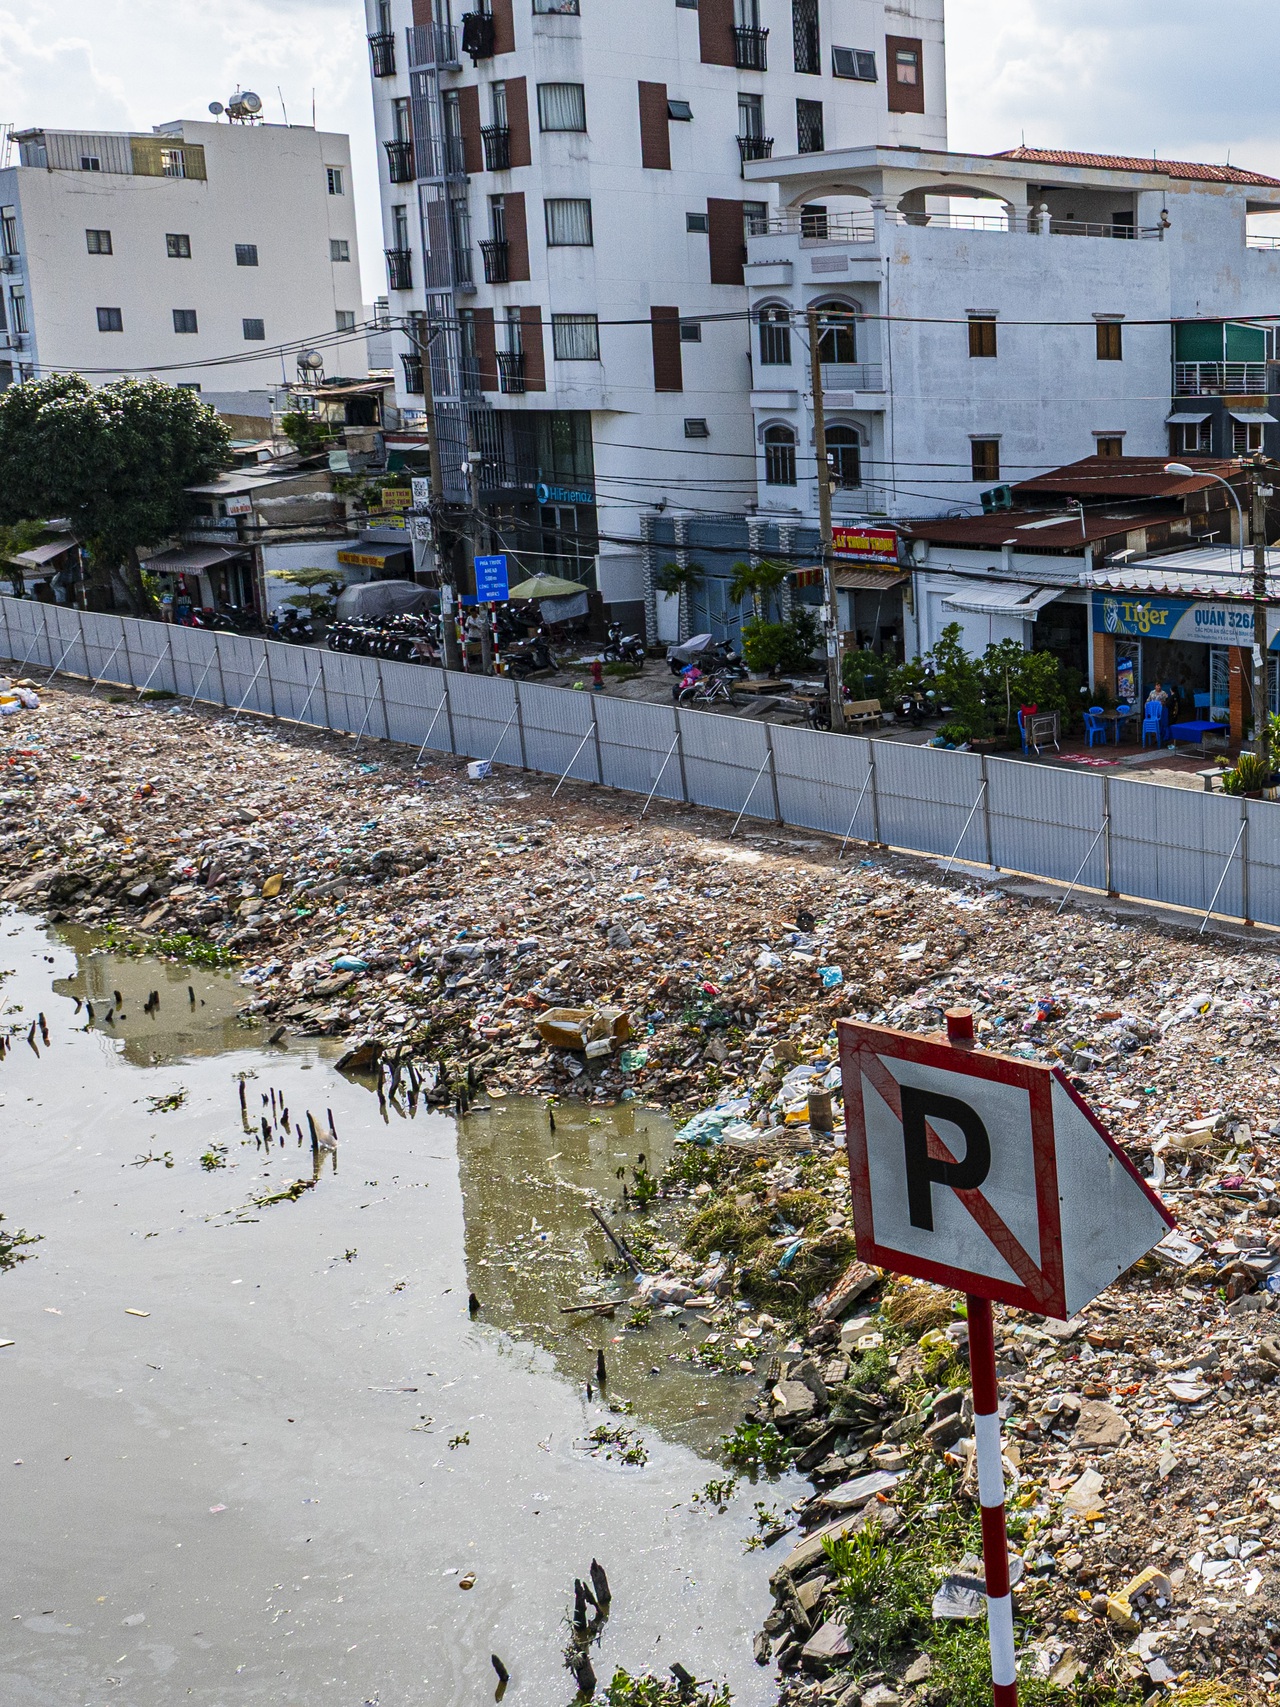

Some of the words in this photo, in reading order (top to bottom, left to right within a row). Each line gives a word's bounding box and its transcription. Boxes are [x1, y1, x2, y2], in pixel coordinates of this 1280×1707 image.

[1121, 601, 1169, 633] Tiger
[1194, 607, 1226, 626] QUÁN
[900, 1085, 992, 1232] P
